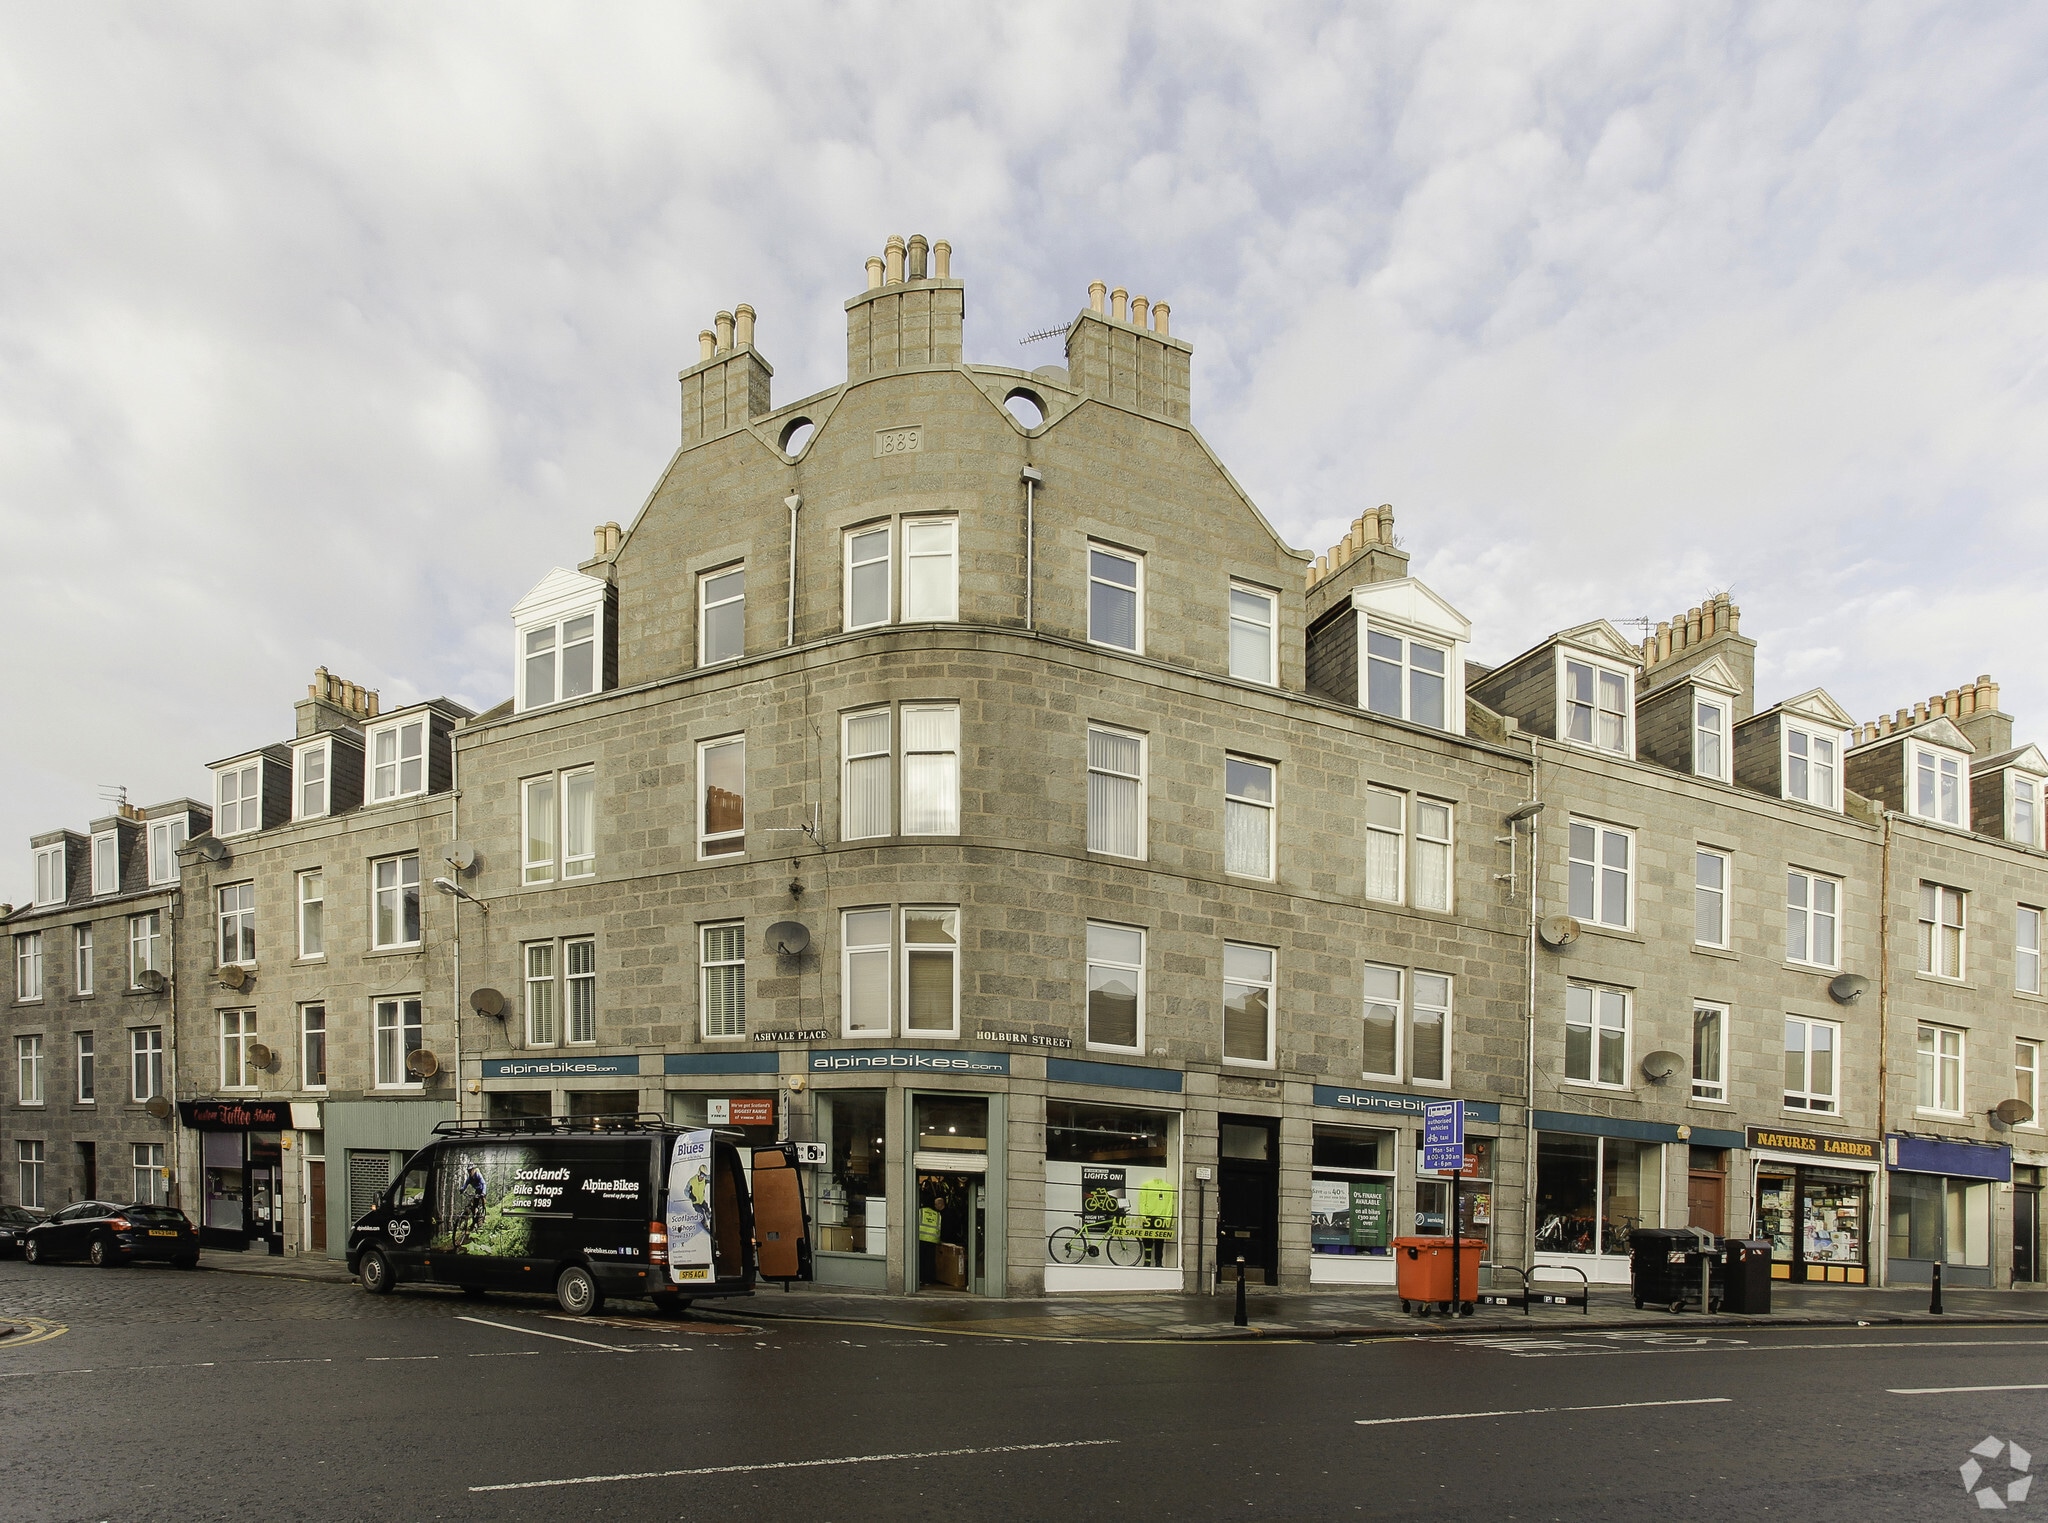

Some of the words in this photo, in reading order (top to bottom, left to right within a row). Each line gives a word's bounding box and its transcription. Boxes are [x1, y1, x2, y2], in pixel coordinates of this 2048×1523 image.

[880, 432, 919, 454] 1889
[754, 1032, 795, 1041] ASHVALE
[798, 1030, 827, 1040] PLACE
[976, 1030, 1028, 1043] HOLBURN
[1032, 1035, 1072, 1048] STREET
[500, 1062, 617, 1075] alpinebikes.com
[813, 1054, 1002, 1070] alpinebikes.com
[218, 1105, 251, 1125] Tattoo
[253, 1108, 276, 1122] Studio
[1427, 1117, 1452, 1125] authorised
[677, 1143, 704, 1156] Blues
[1757, 1132, 1816, 1151] NATURES
[1824, 1140, 1873, 1157] LARDER
[514, 1167, 570, 1181] Scotland's
[1084, 1172, 1108, 1180] LIGHTS
[513, 1185, 532, 1195] Bike
[534, 1184, 563, 1197] Shops
[582, 1178, 613, 1193] Alpine
[613, 1179, 639, 1191] Bikes
[512, 1199, 531, 1207] since
[533, 1198, 552, 1208] 1989
[672, 1213, 703, 1223] Scotland's
[1112, 1216, 1151, 1227] LIGHTS
[1153, 1219, 1175, 1228] ON!
